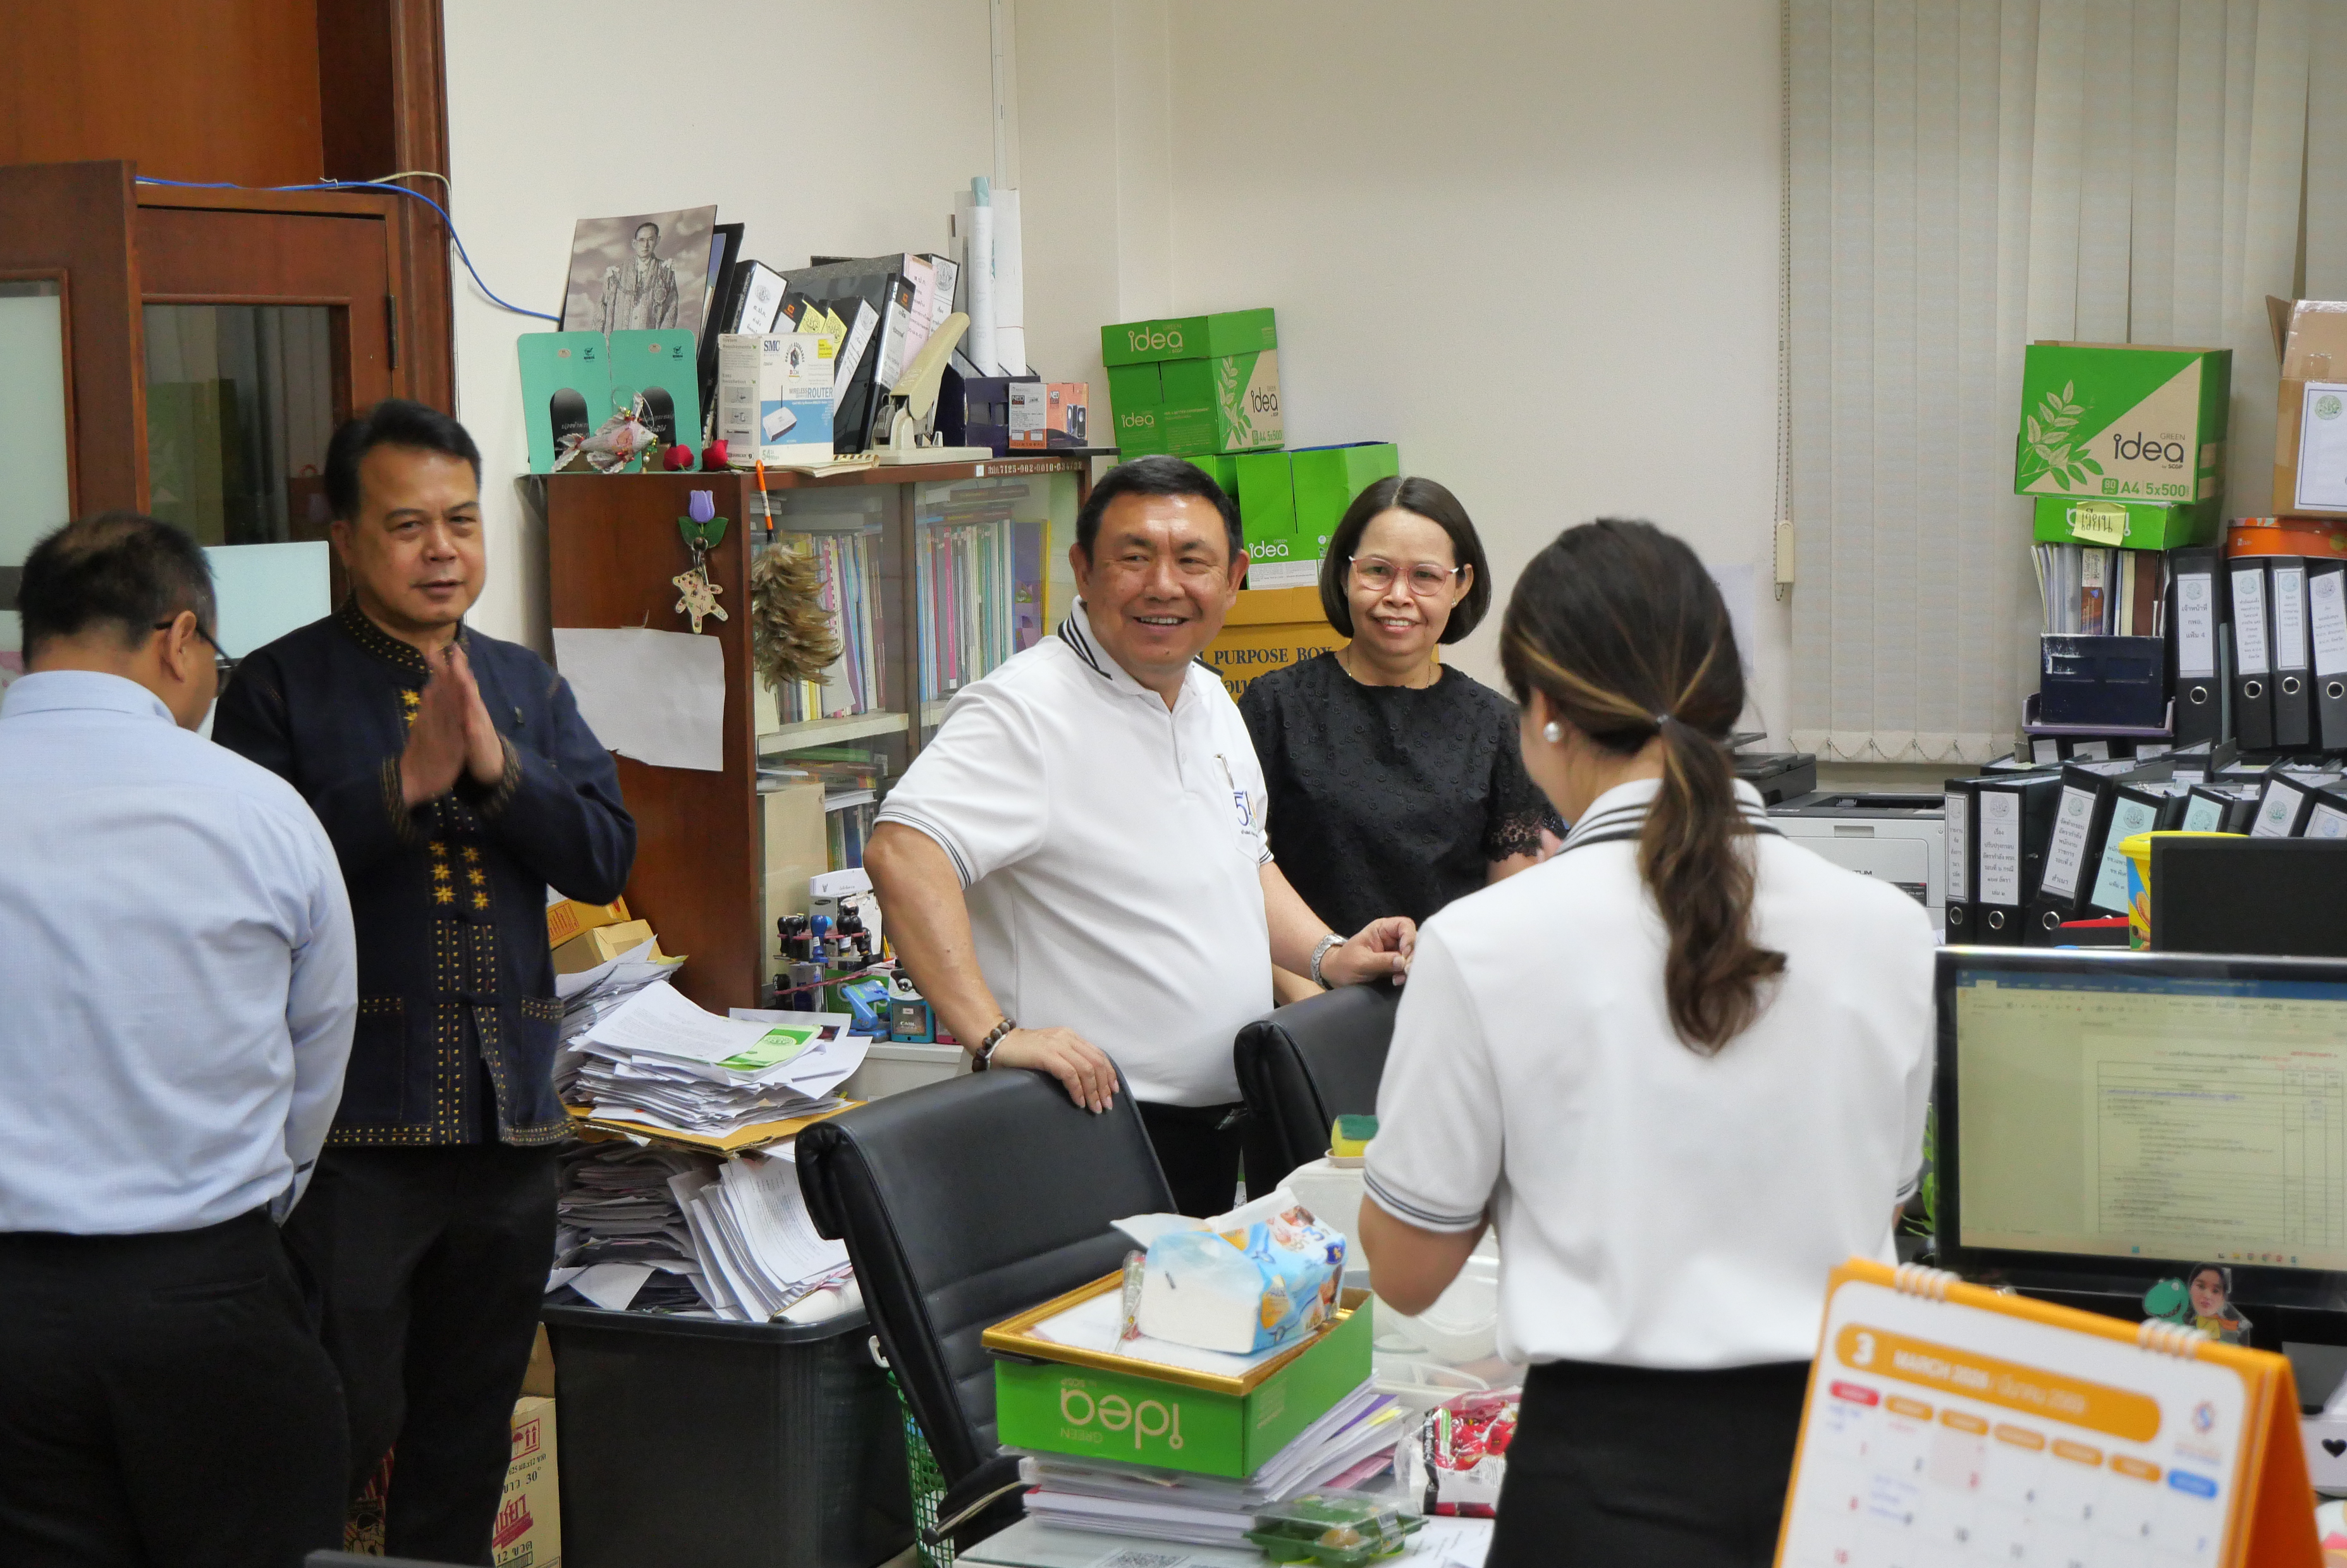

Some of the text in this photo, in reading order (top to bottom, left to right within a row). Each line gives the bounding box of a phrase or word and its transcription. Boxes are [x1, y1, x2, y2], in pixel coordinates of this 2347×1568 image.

[763, 340, 780, 352] SMC
[1128, 326, 1184, 352] idea
[807, 387, 834, 398] ROUTER
[1251, 387, 1278, 413] idea
[1121, 412, 1155, 428] idea
[2160, 432, 2185, 441] GREEN
[2113, 431, 2184, 463] idea
[2121, 481, 2186, 497] A4 5x500
[1249, 540, 1289, 559] idea
[1215, 648, 1289, 665] PURPOSE
[1852, 1332, 1877, 1366] 3
[1893, 1348, 1951, 1380] MARCH
[1061, 1388, 1184, 1450] idea
[1060, 1428, 1105, 1444] GREEN
[508, 1464, 518, 1476] 625
[497, 1540, 533, 1564] 12 ขวด
